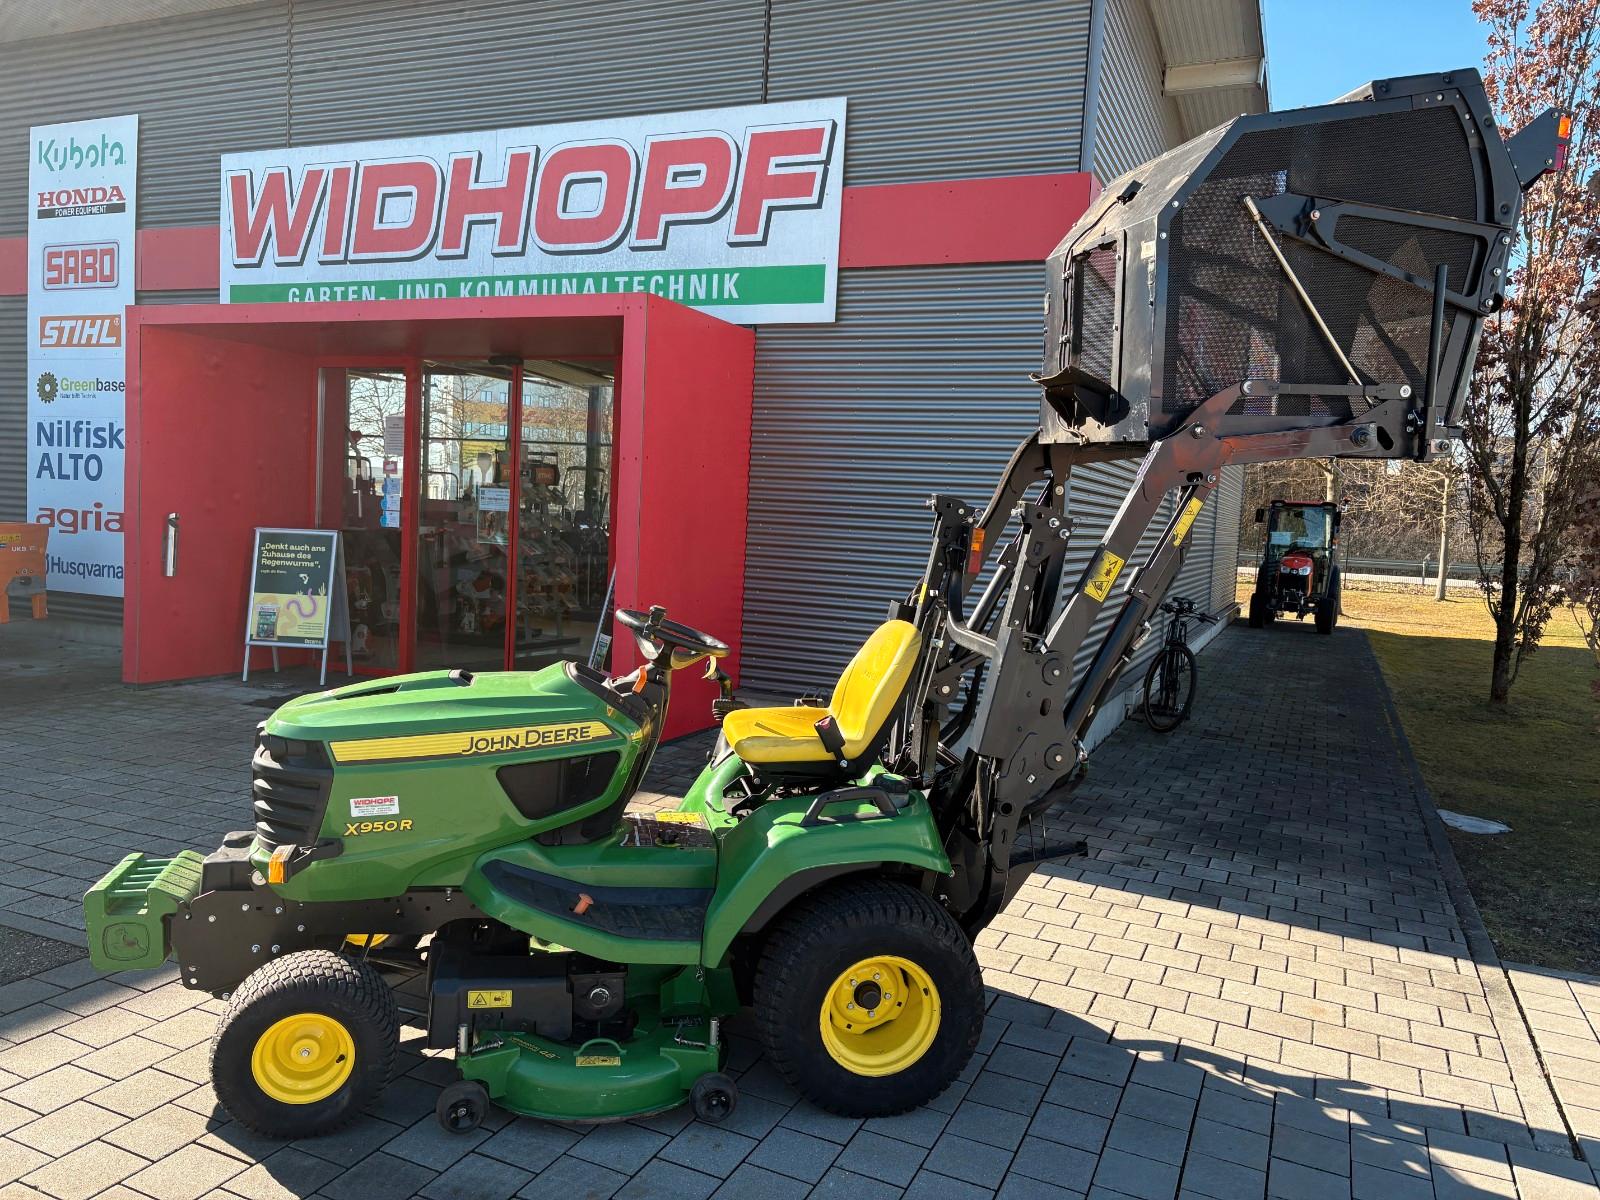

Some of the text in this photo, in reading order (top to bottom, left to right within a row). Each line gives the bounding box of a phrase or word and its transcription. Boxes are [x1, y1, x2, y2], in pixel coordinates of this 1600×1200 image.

[38, 134, 125, 172] Kubota
[38, 186, 126, 207] HONDA
[225, 119, 836, 268] WIDHOPF
[55, 205, 107, 217] POWER EQUIPMENT
[46, 247, 115, 285] SABO
[61, 378, 125, 391] Greenbase
[36, 421, 124, 449] Nilfisk
[36, 453, 103, 481] ALTO
[36, 502, 124, 534] agria
[51, 556, 123, 579] Husqvarna
[461, 726, 592, 753] JOHN DEERE
